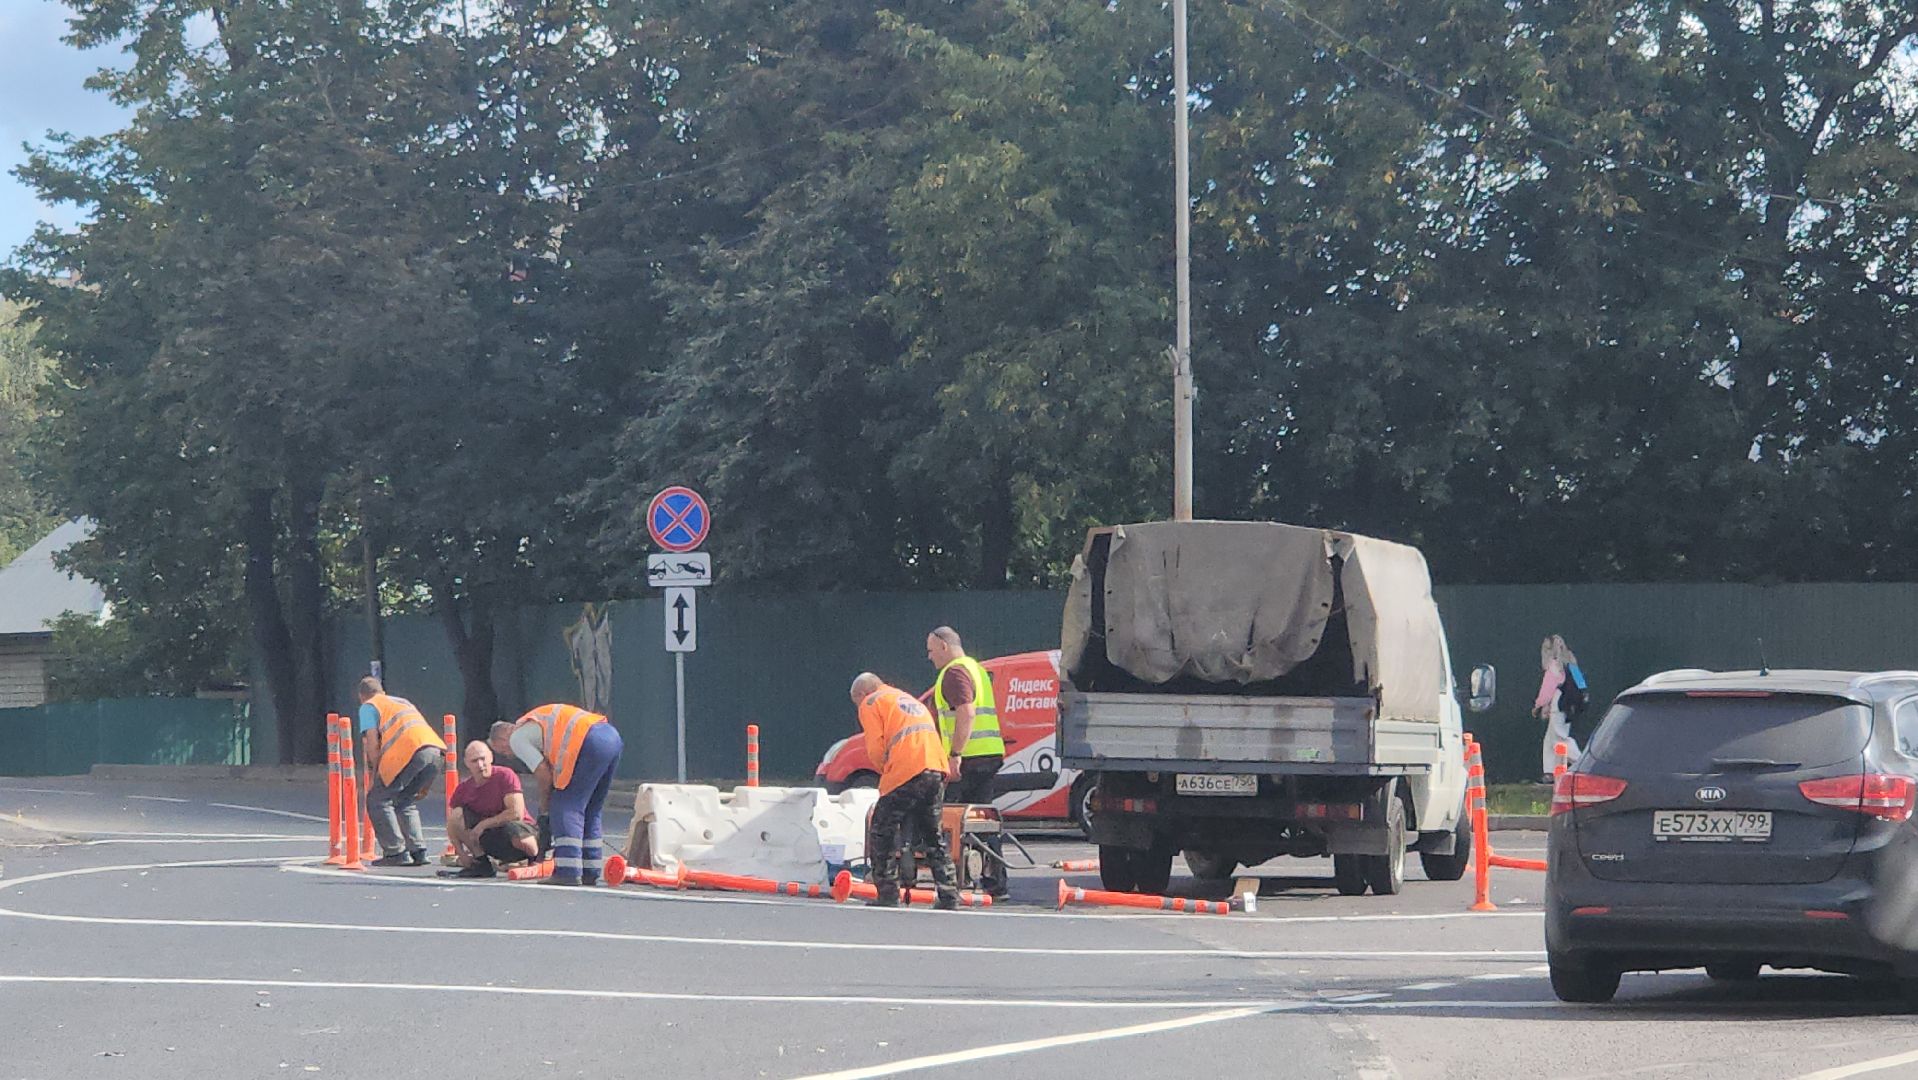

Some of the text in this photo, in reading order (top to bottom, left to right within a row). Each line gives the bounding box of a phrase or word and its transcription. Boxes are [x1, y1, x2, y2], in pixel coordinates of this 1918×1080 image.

[1008, 678, 1054, 693] Яндекс
[1004, 695, 1058, 712] Доставк
[1699, 789, 1721, 799] KIA
[1737, 813, 1767, 829] 799
